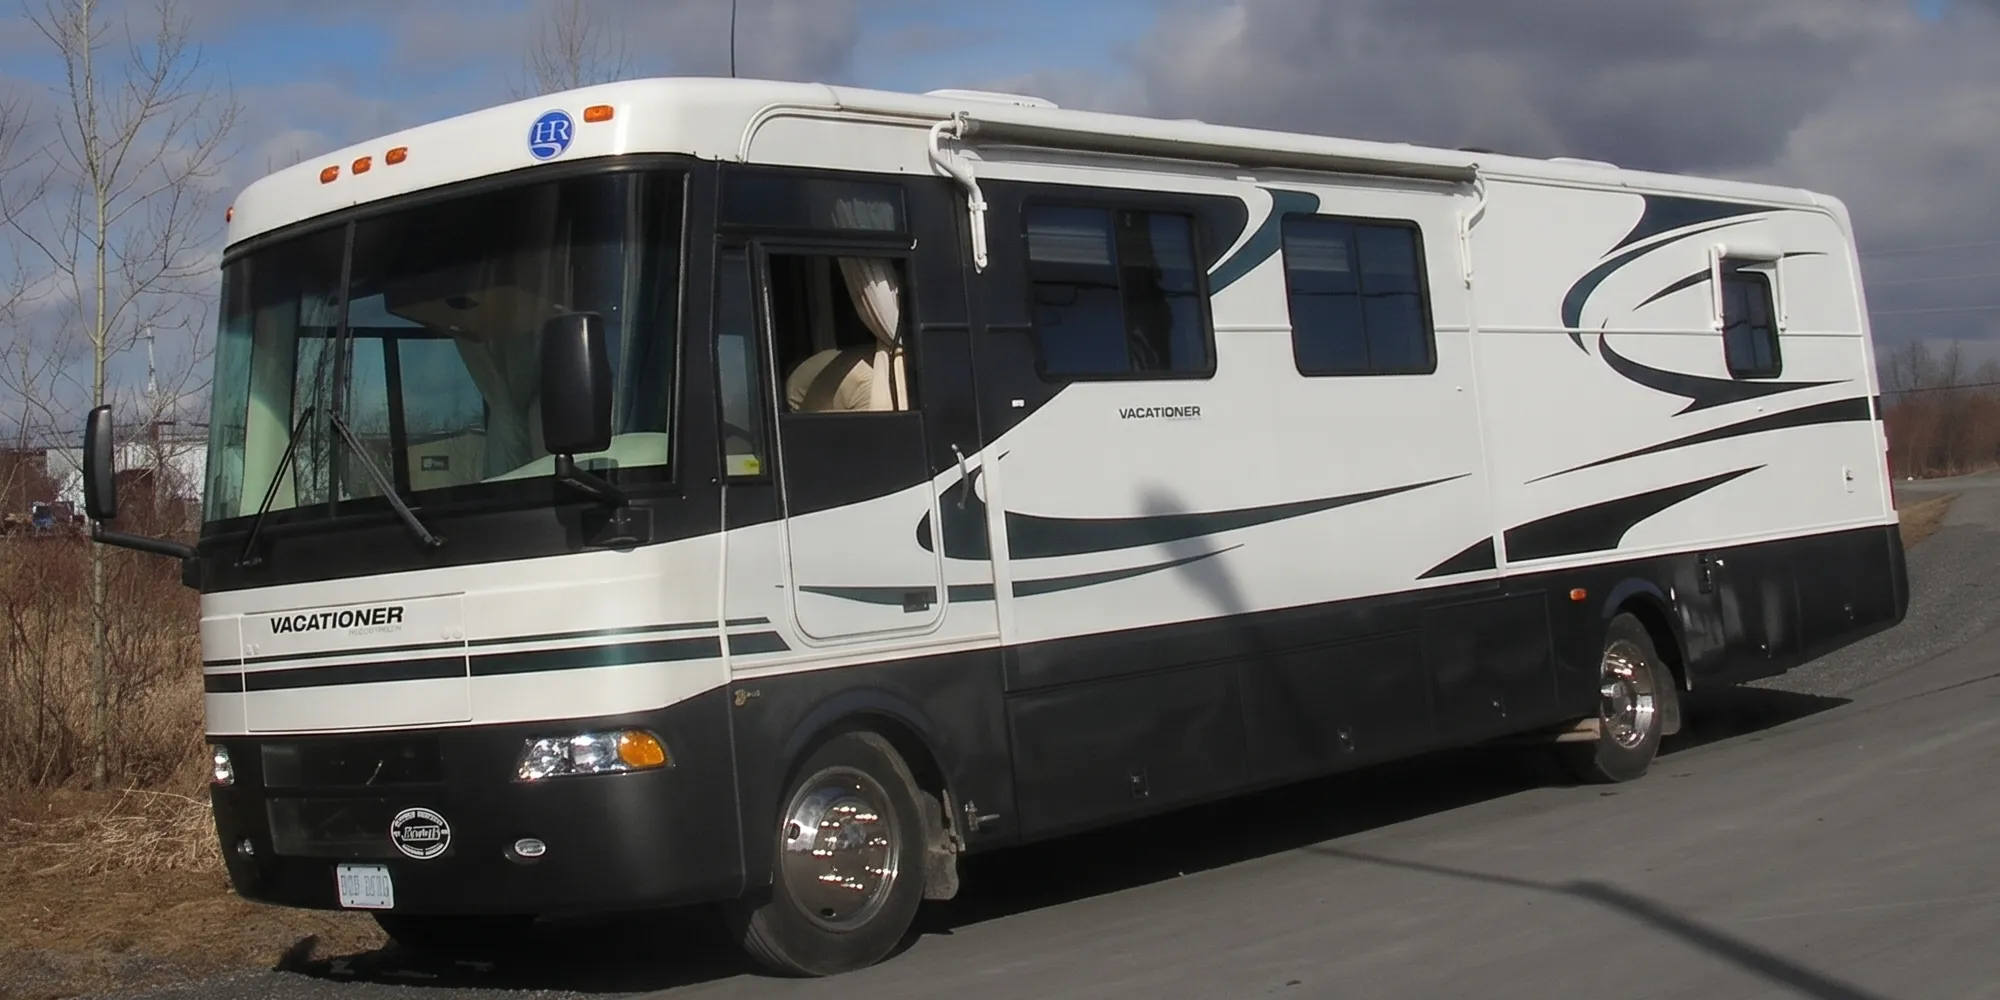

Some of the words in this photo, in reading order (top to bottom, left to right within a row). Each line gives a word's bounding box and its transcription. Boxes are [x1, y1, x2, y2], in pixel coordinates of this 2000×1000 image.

[534, 120, 569, 143] HR
[1119, 406, 1201, 419] VACATIONER
[270, 606, 404, 634] VACATIONER
